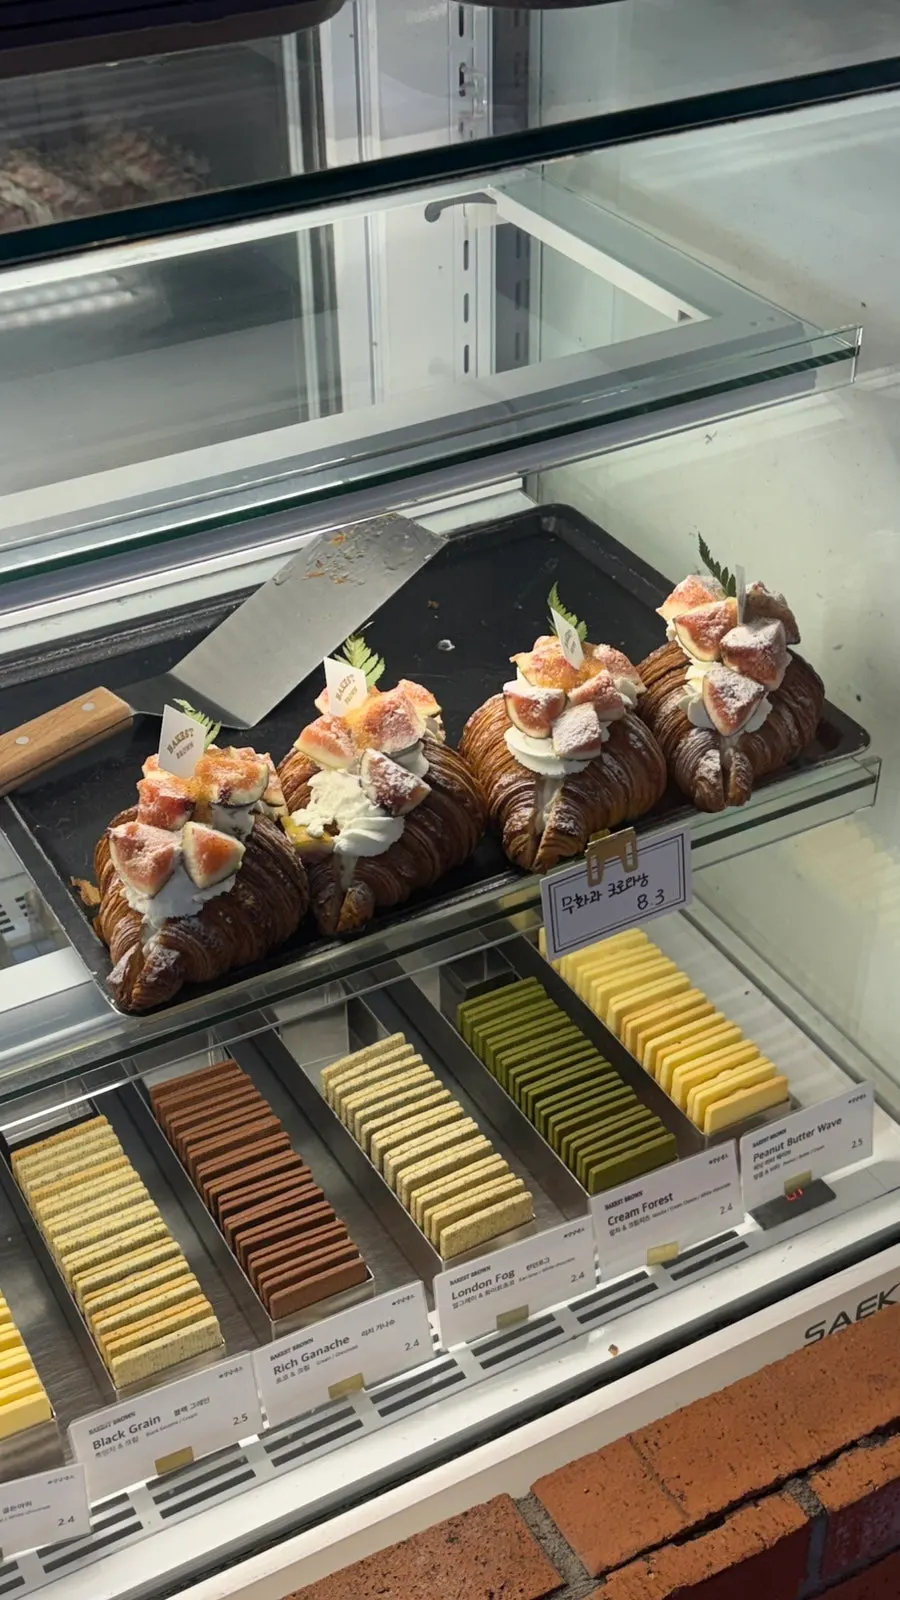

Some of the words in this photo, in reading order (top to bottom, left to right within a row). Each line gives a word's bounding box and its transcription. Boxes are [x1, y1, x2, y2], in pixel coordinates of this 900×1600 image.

[561, 890, 603, 914] 무화과
[637, 888, 665, 910] 8.3
[753, 1142, 785, 1162] Peanut
[787, 1129, 815, 1147] Butter
[817, 1117, 842, 1133] Wave
[851, 1138, 863, 1149] 2.5
[607, 1206, 640, 1226] Cream
[641, 1193, 674, 1213] Forest
[720, 1203, 733, 1215] 2.4
[451, 1279, 492, 1301] London
[495, 1269, 515, 1284] Fog
[570, 1271, 585, 1283] 2.4
[273, 1358, 299, 1376] Rich
[300, 1336, 350, 1363] Ganache
[404, 1339, 420, 1351] 2.4
[232, 1413, 249, 1426] 2.5
[92, 1430, 126, 1450] Black
[128, 1414, 161, 1435] Grain
